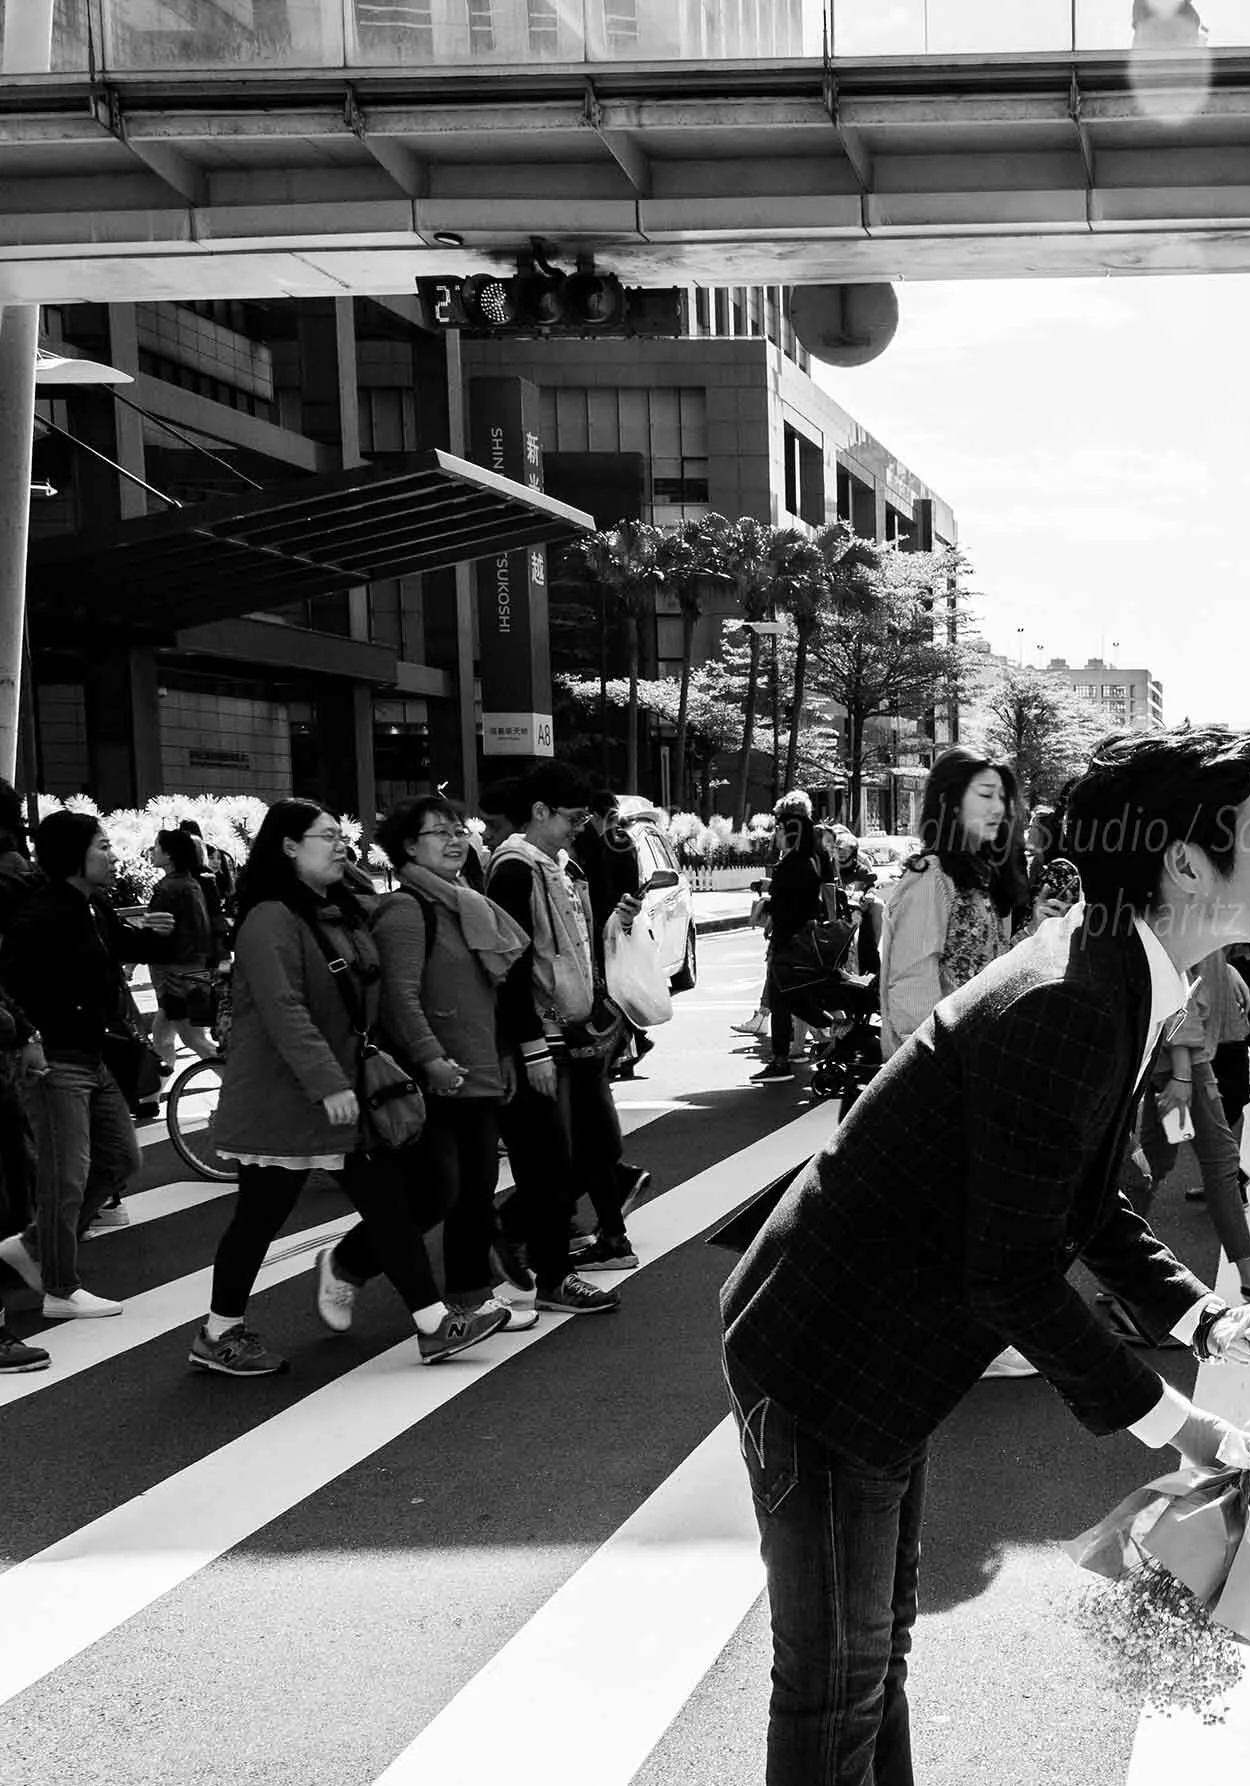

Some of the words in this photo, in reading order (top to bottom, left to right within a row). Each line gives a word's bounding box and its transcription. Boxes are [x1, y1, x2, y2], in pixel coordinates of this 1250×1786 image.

[491, 427, 505, 469] SHIN
[496, 552, 511, 633] SUKOSHI
[537, 723, 551, 747] A8
